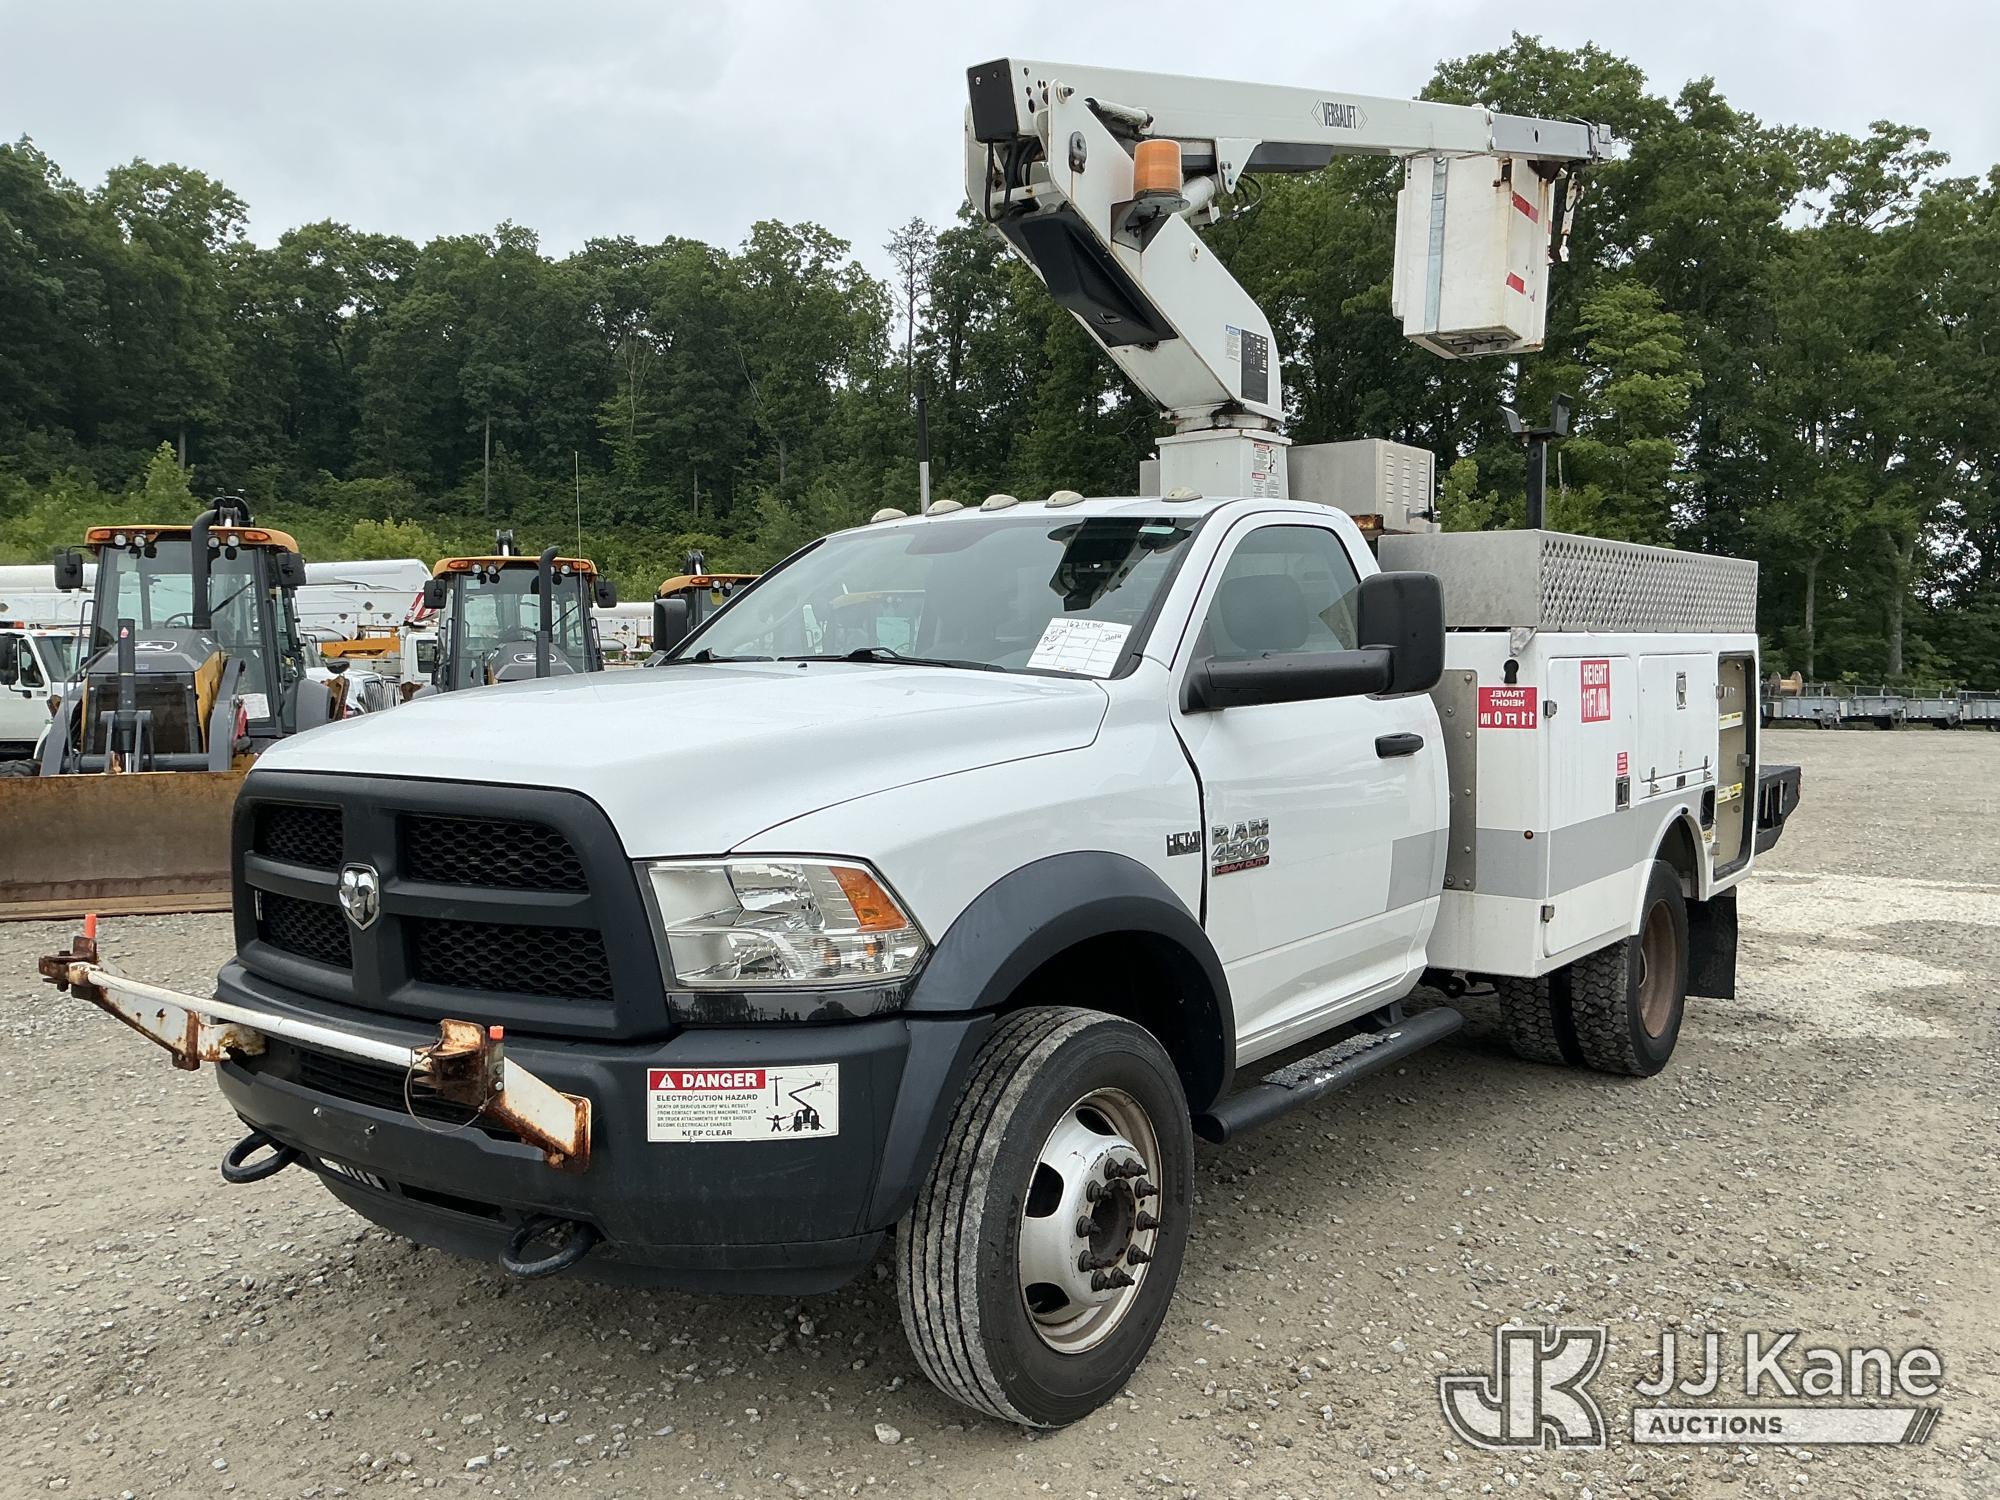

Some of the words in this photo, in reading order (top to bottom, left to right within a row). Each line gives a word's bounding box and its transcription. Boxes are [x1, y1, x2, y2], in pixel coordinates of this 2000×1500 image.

[1322, 102, 1357, 129] VERSALIFT
[1583, 664, 1608, 685] HEIGHT
[1166, 831, 1201, 849] HEMI
[1211, 818, 1269, 846] RAM
[1211, 836, 1270, 862] 4500
[1216, 861, 1244, 874] HEAVY
[1245, 857, 1269, 869] DUTY
[682, 1072, 757, 1088] DANGER
[656, 1094, 723, 1102] ELECTROCUTION
[725, 1093, 758, 1101] HAZARD
